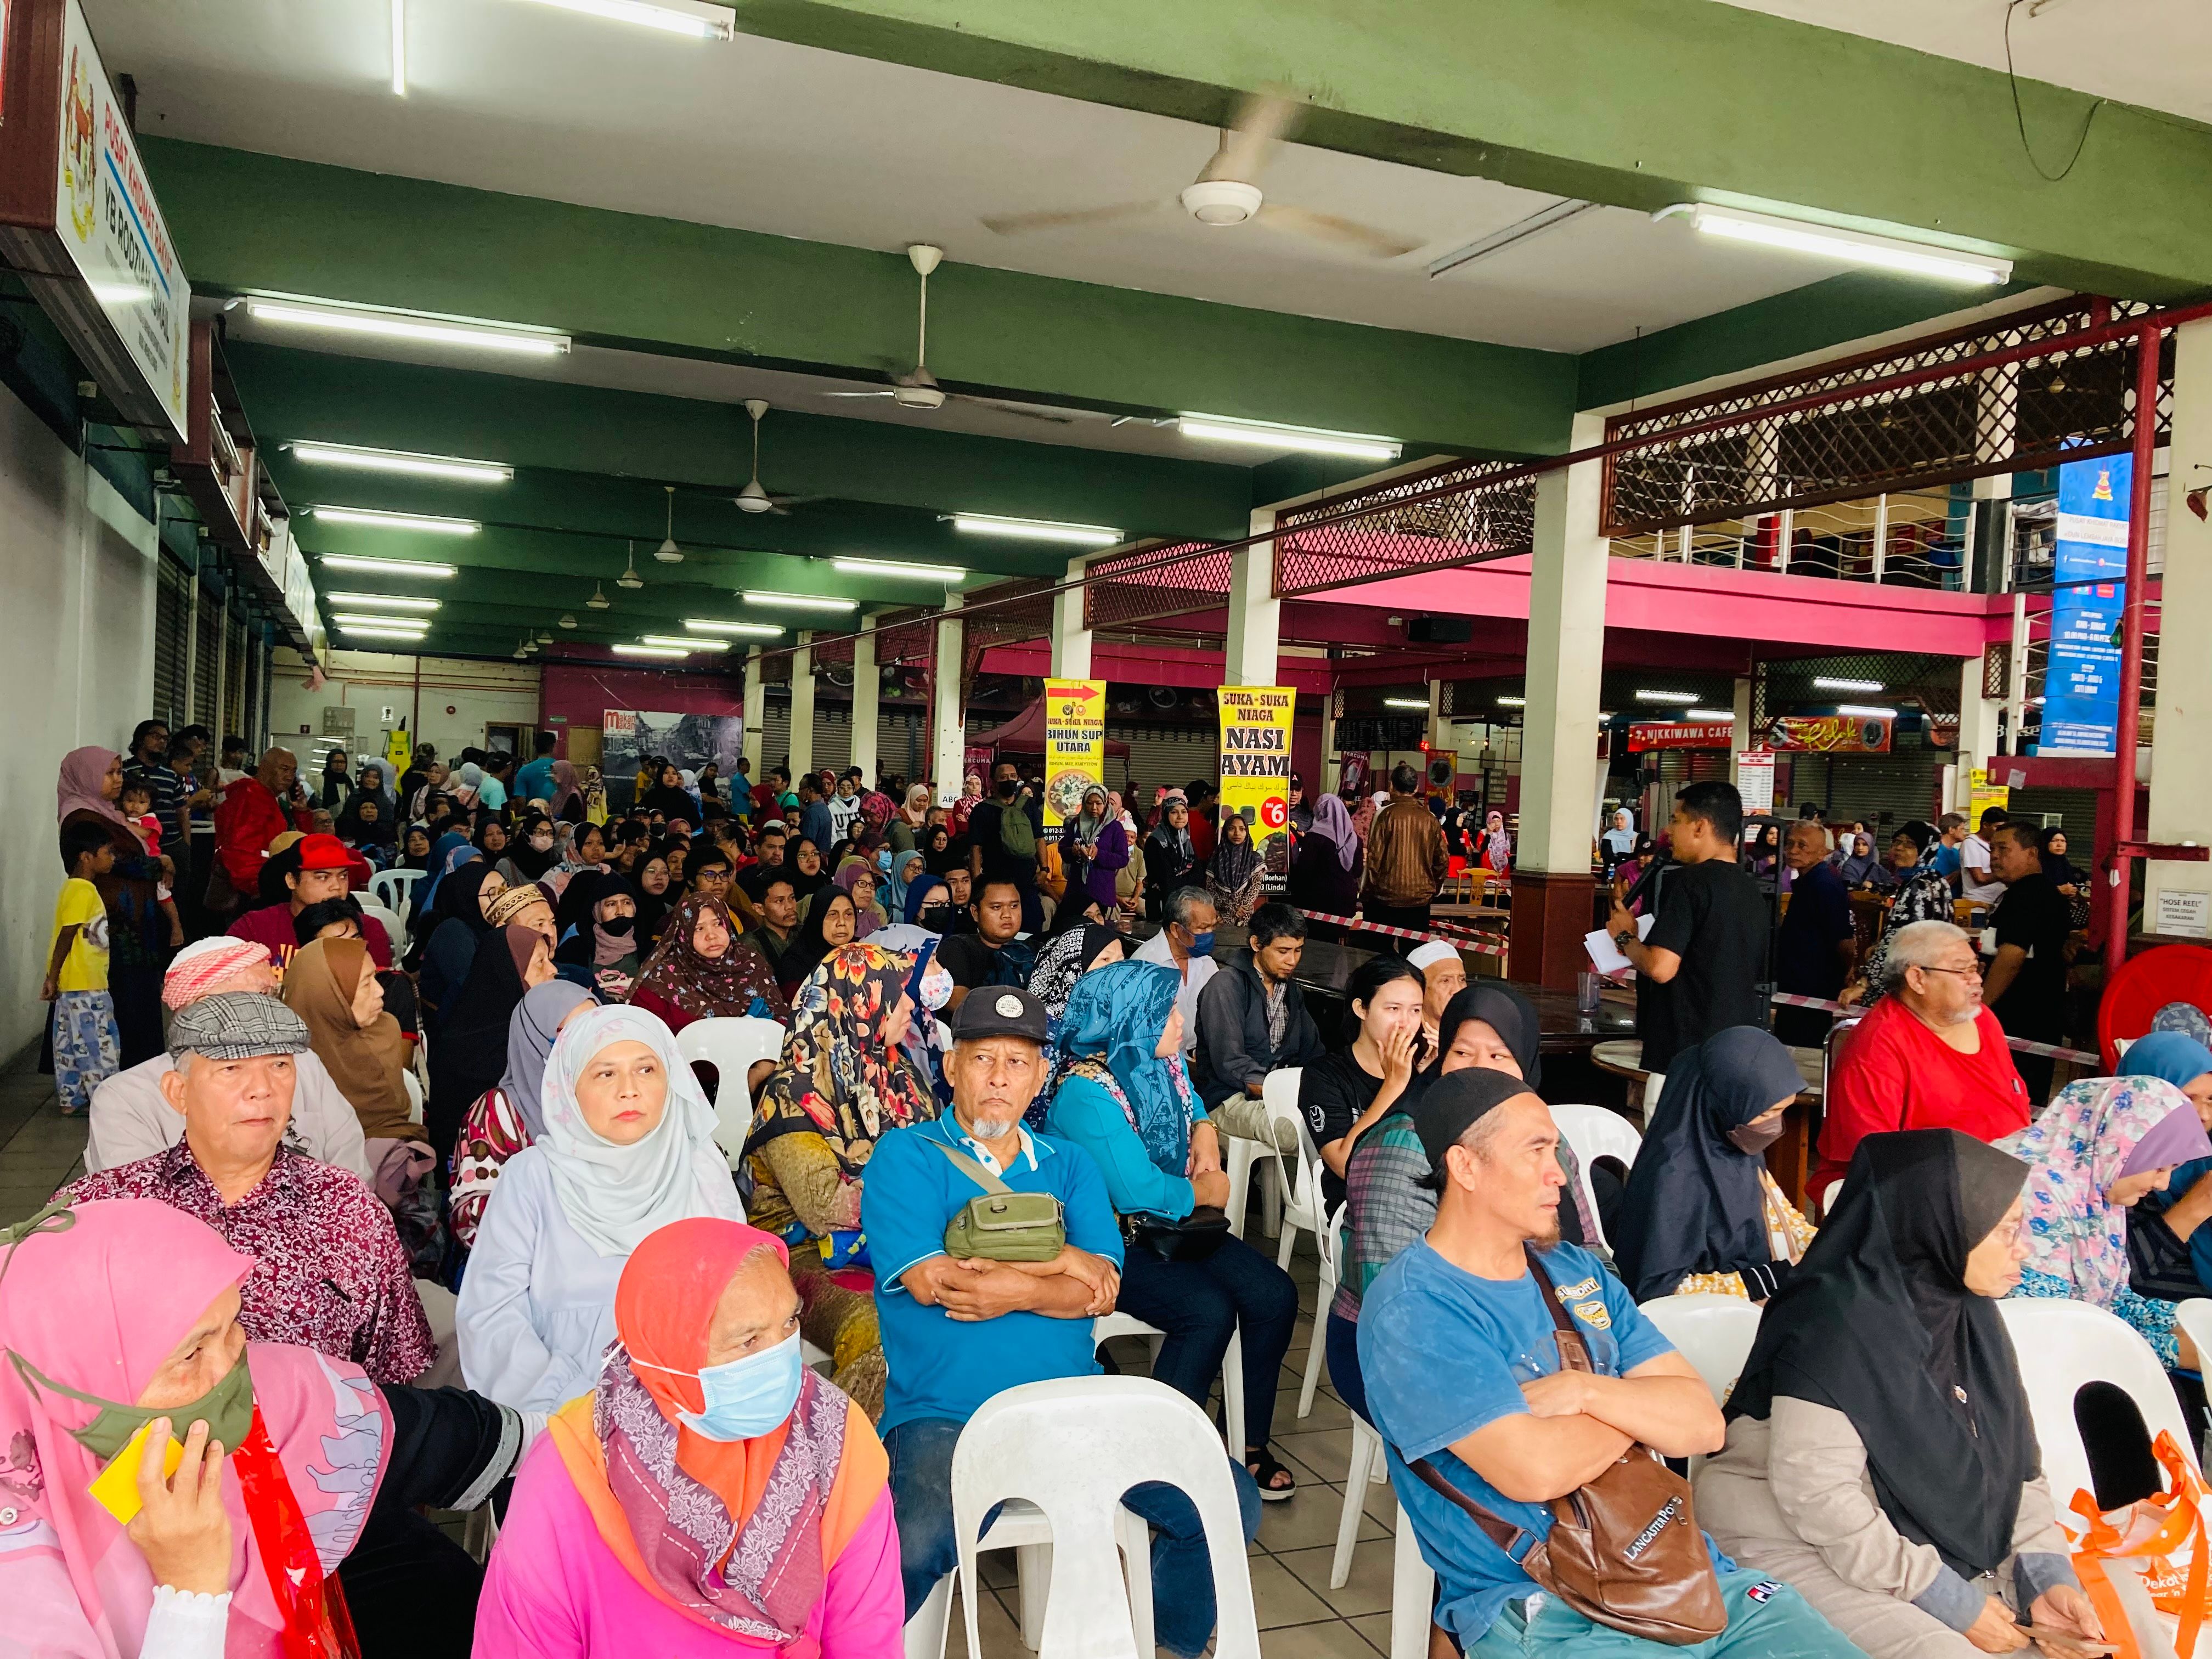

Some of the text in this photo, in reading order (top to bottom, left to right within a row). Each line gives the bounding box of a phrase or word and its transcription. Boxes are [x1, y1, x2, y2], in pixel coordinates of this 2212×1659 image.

[105, 100, 128, 178] PUSAT
[104, 177, 116, 235] YB
[1238, 709, 1273, 721] NIAGA
[1081, 730, 1102, 740] SUP
[1226, 728, 1284, 750] NASI
[1647, 726, 1733, 740] NIKKIWAWA CAFE
[1057, 742, 1091, 752] UTARA
[1222, 754, 1289, 777] AYAM
[1271, 803, 1284, 823] 6
[1262, 874, 1287, 882] (Borhan)
